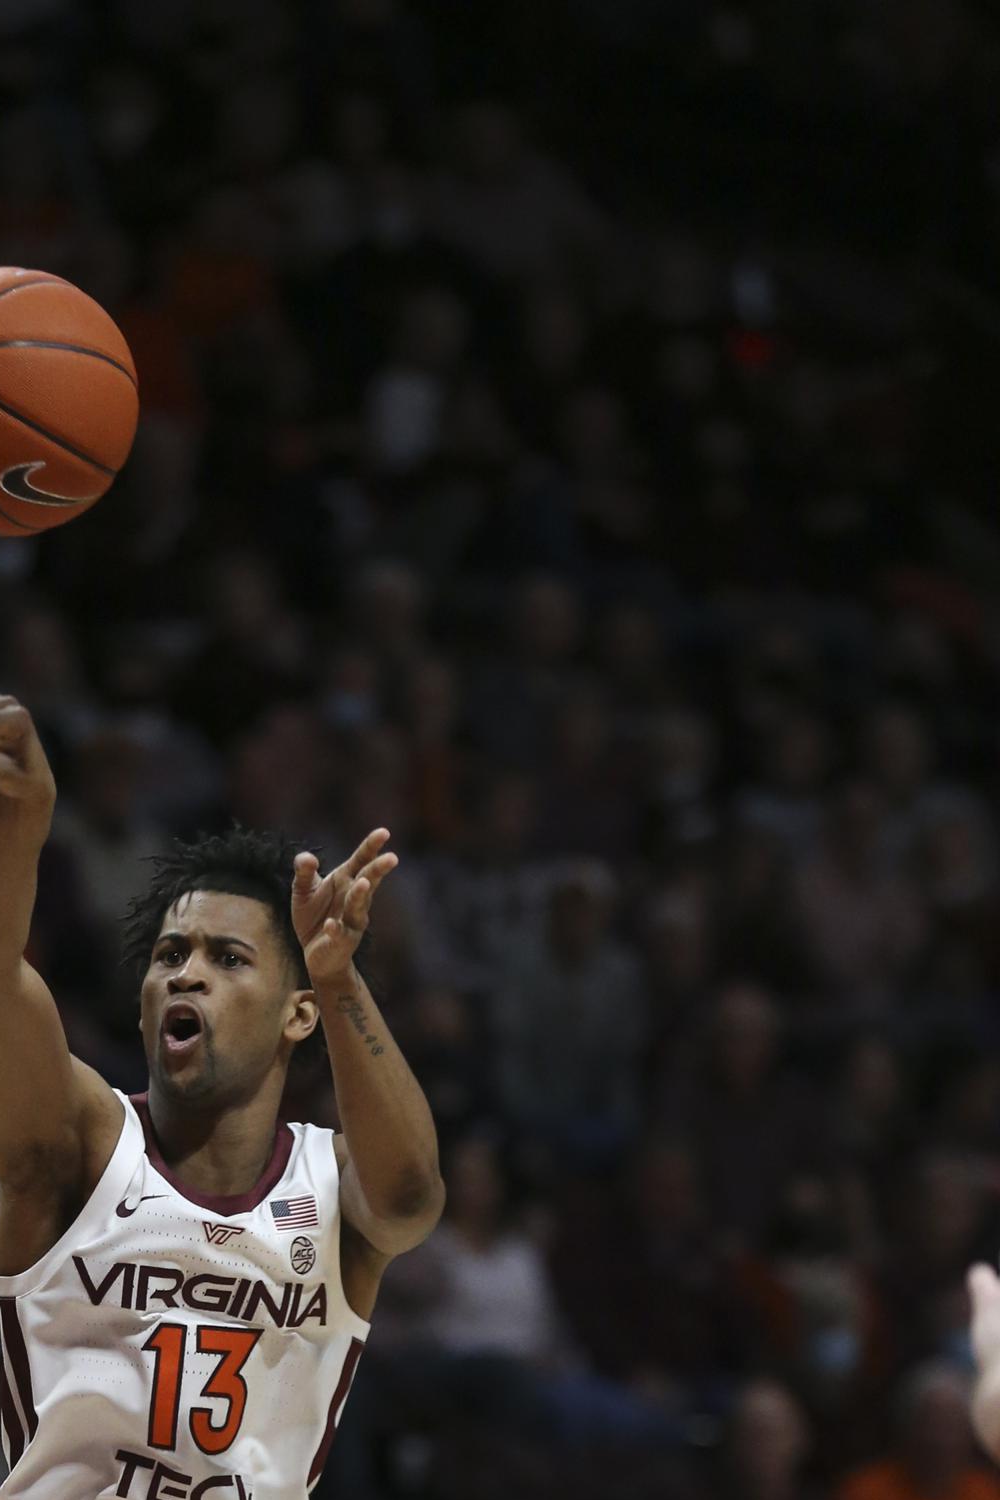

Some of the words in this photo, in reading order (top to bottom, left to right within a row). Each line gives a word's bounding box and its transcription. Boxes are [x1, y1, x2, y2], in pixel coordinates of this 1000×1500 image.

[202, 1221, 245, 1245] VT
[293, 1247, 314, 1259] ACC
[71, 1255, 327, 1329] VIRGINIA
[141, 1322, 265, 1455] 13
